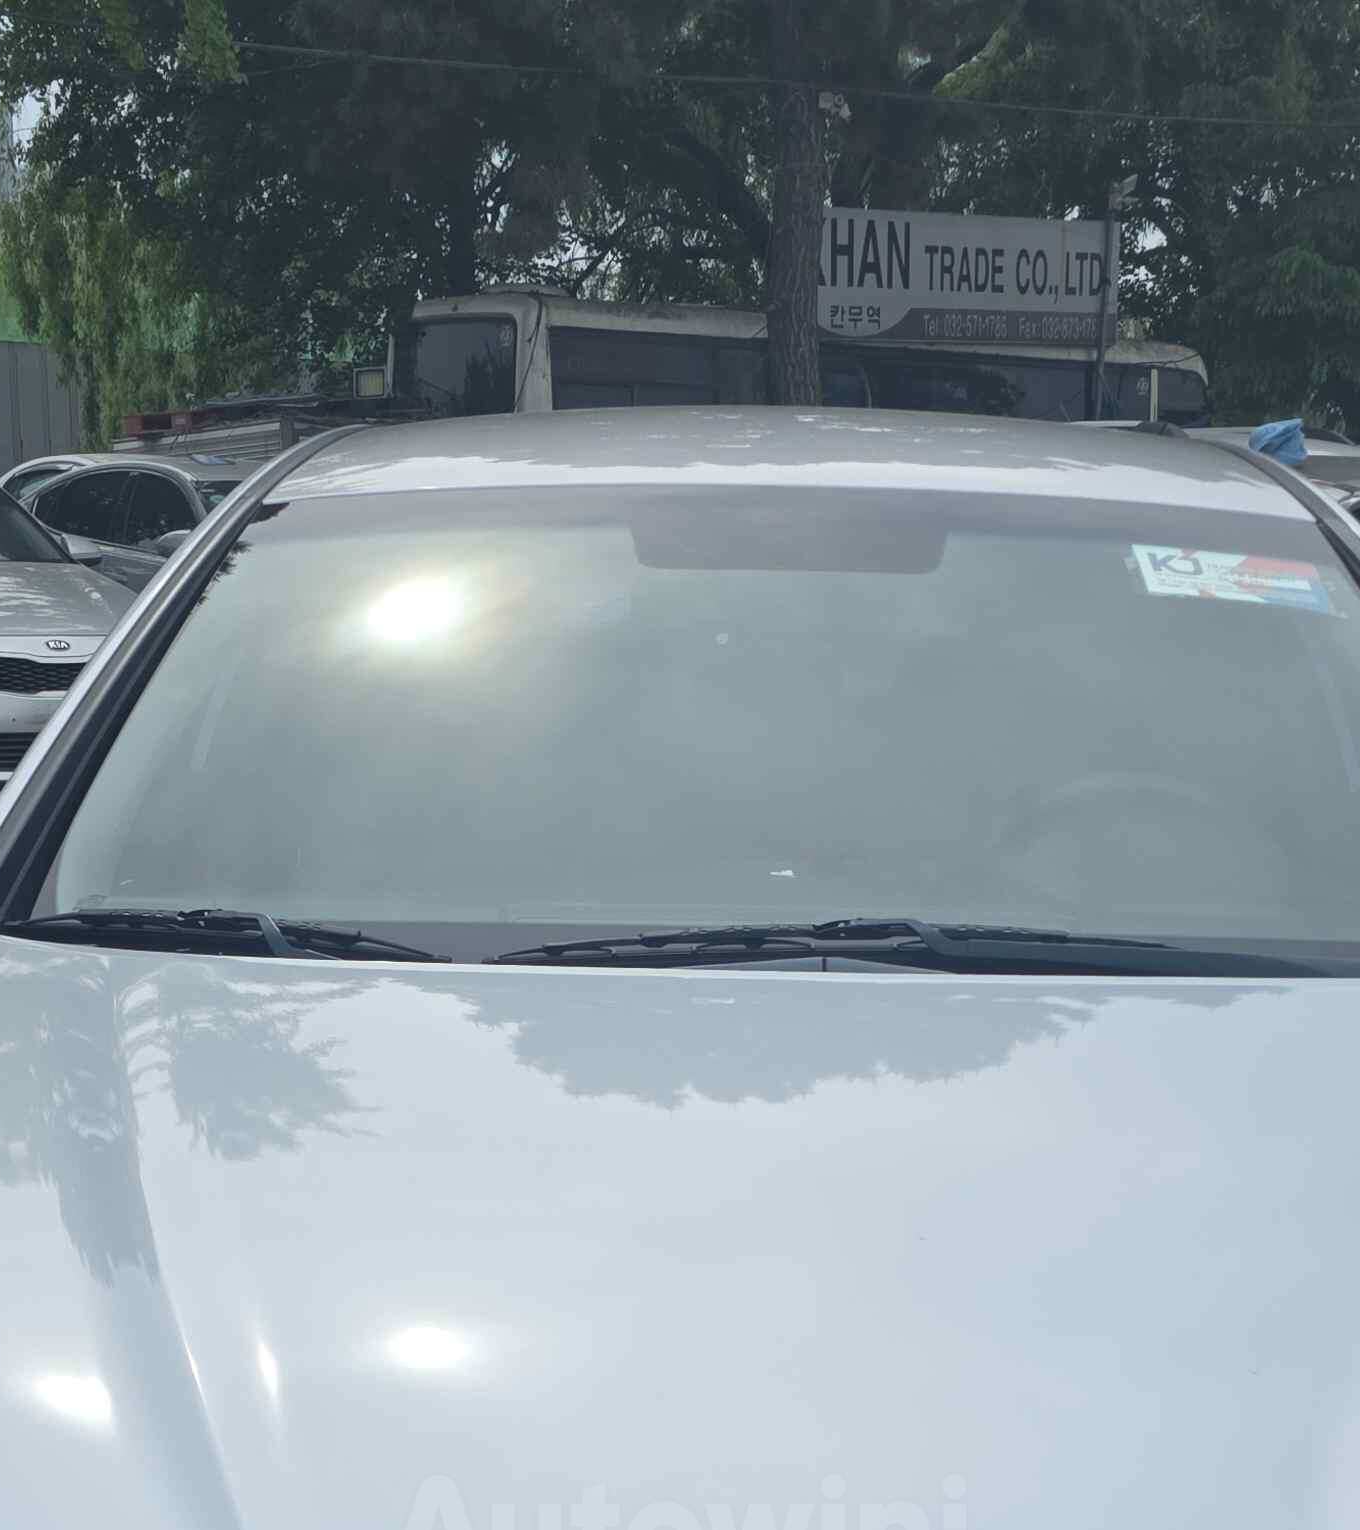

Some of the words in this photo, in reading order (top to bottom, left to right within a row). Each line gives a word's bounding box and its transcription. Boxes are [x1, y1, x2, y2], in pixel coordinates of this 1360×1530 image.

[924, 245, 1005, 294] TRADE
[829, 304, 881, 330] 칸무역
[47, 640, 70, 649] KIA
